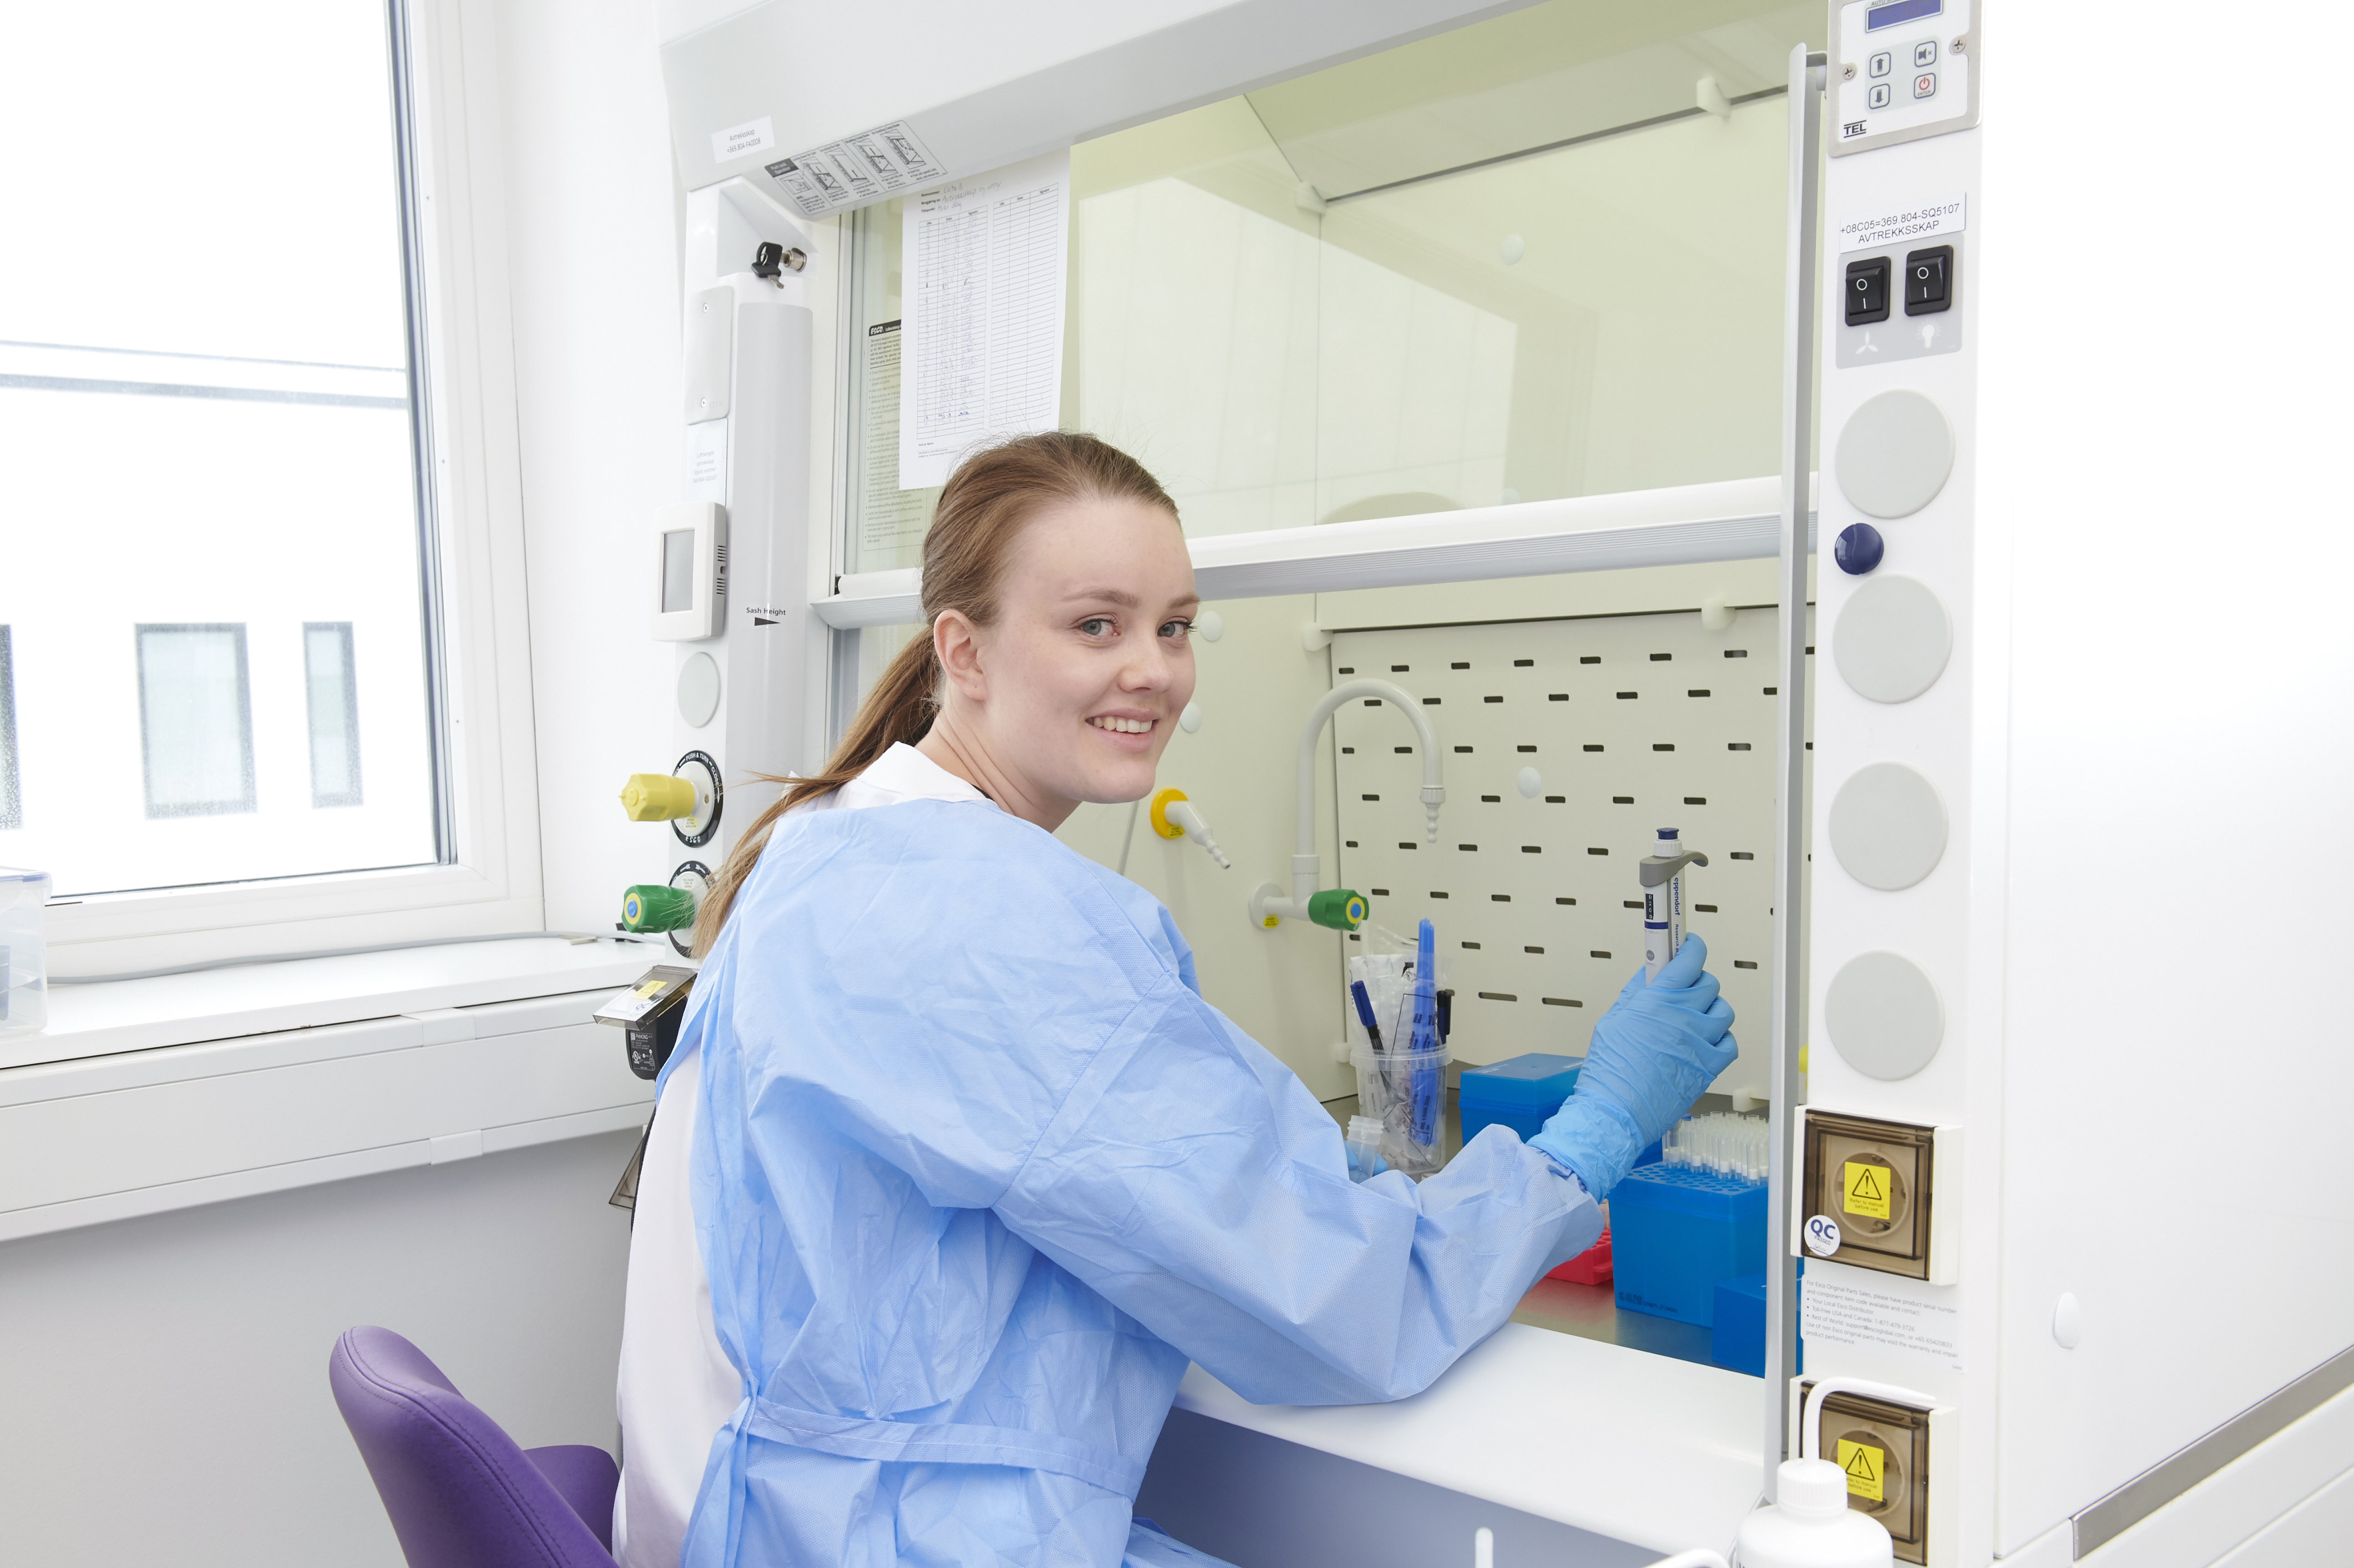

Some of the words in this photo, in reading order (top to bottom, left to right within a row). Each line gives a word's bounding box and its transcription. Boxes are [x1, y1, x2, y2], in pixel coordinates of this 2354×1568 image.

[1844, 123, 1866, 135] TEL
[773, 166, 791, 174] Operation
[1840, 203, 1960, 234] +08C05=369.804-SQ5107
[1858, 220, 1940, 244] AVTREKKSSKAP
[870, 326, 883, 335] ESCO
[686, 752, 696, 761] PUSH
[699, 752, 710, 763] TURN
[711, 766, 720, 785] CLOSE
[1673, 877, 1681, 916] eppendorf
[1810, 1219, 1836, 1240] QC
[1814, 1235, 1831, 1245] PASSED
[1849, 1305, 1874, 1315] Distributor
[1812, 1306, 1831, 1314] Toll-Free
[1854, 1315, 1872, 1323] Canada:
[1875, 1320, 1915, 1331] 1-877-479-3726
[1825, 1334, 1855, 1344] performance
[1926, 1338, 1952, 1348] 65420833
